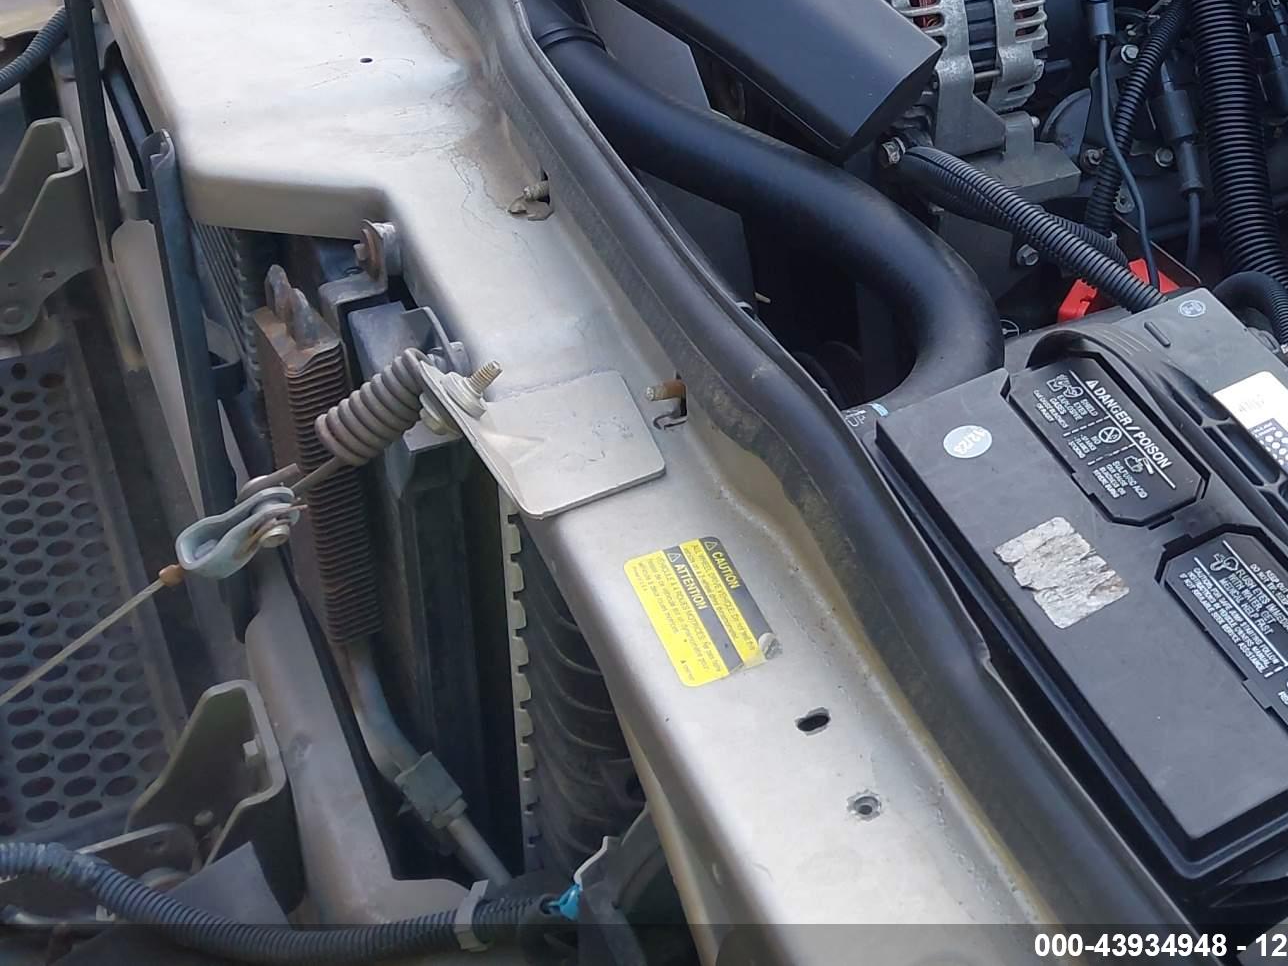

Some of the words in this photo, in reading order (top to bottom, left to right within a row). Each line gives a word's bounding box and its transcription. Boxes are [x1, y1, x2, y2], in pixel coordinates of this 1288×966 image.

[1093, 386, 1132, 426] DANGER
[1132, 429, 1172, 469] POISON
[675, 564, 708, 610] ATTENTION
[712, 551, 740, 590] CAUTION
[1234, 567, 1257, 589] FLUSH
[1251, 587, 1271, 605] EYES
[1218, 576, 1245, 603] MEDICAL
[1239, 601, 1260, 620] HELP
[1253, 617, 1274, 636] FAST
[1226, 572, 1245, 590] WITH
[1259, 609, 1277, 625] GET
